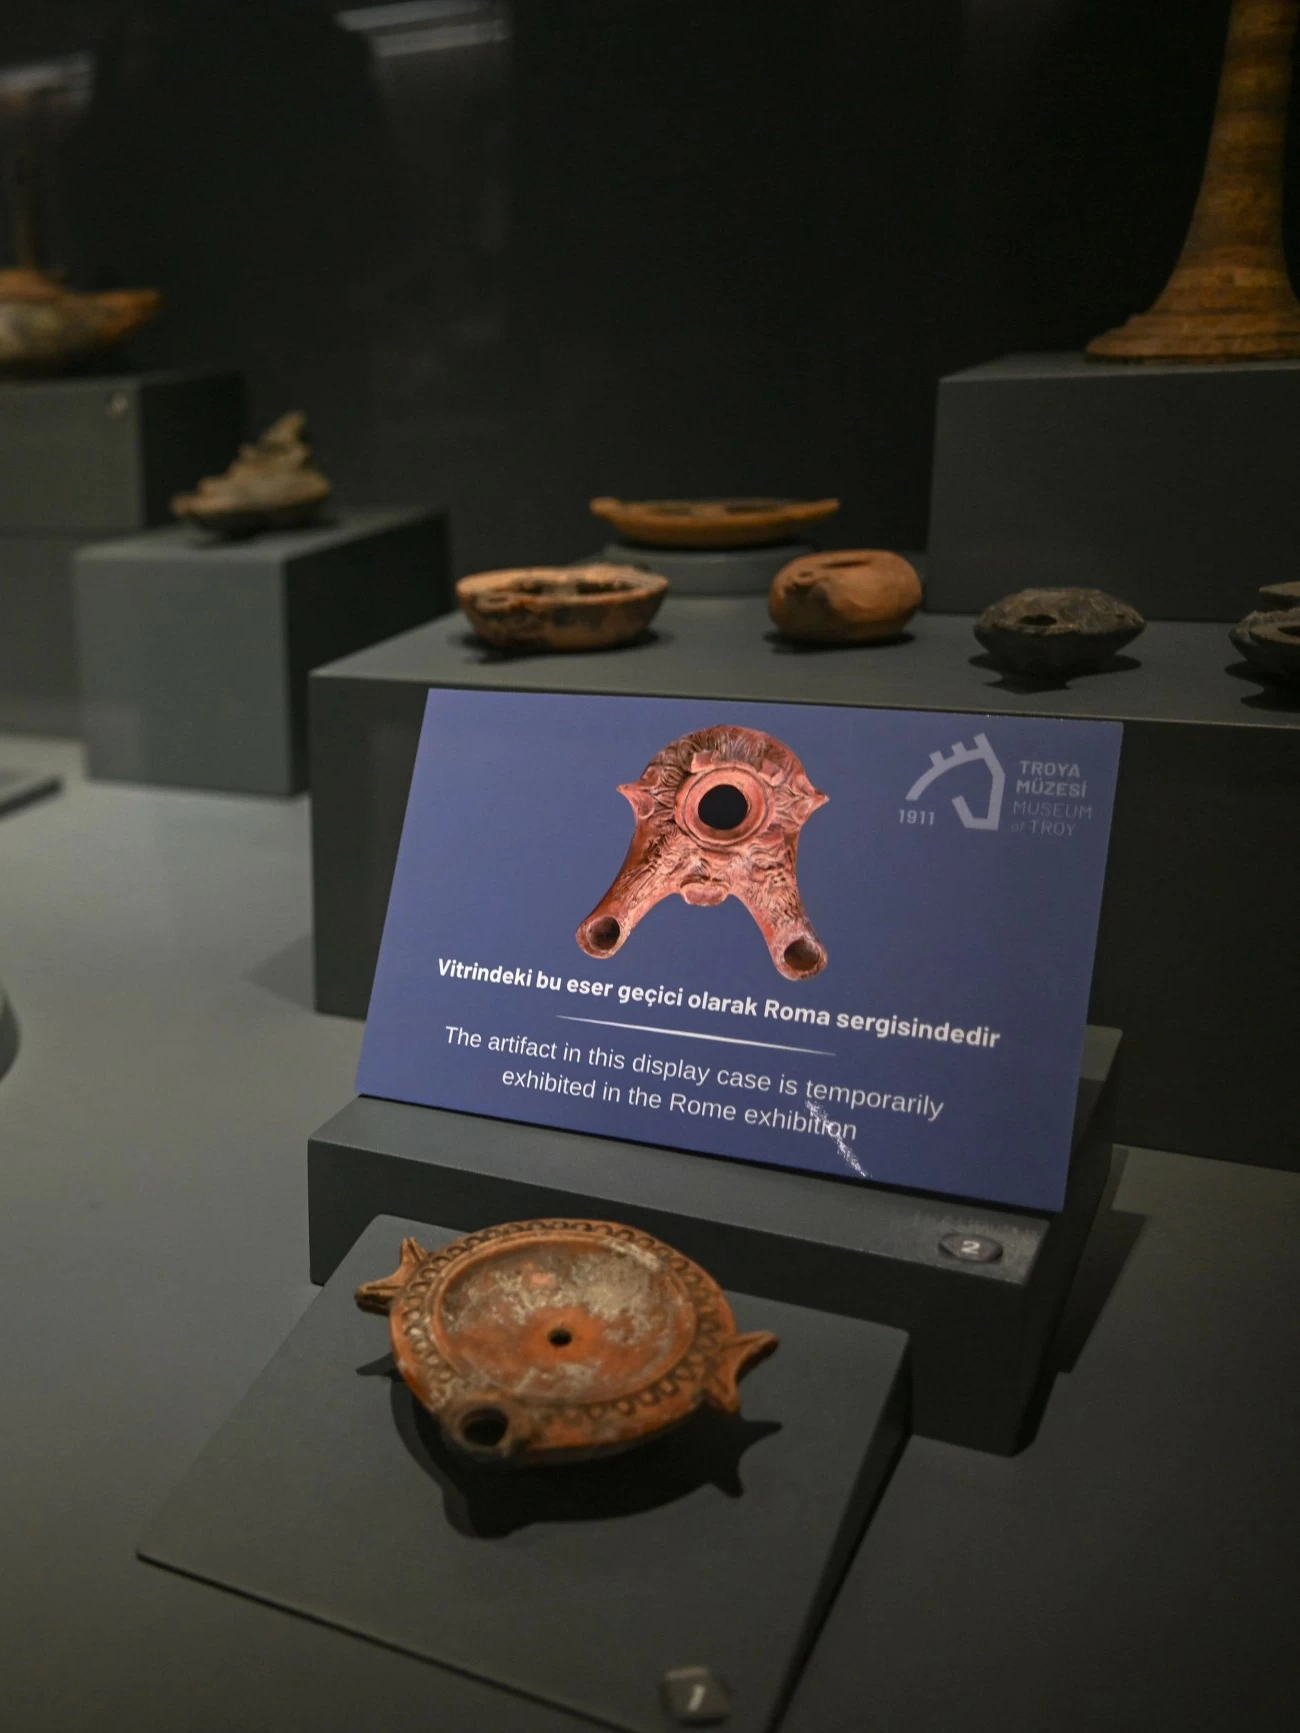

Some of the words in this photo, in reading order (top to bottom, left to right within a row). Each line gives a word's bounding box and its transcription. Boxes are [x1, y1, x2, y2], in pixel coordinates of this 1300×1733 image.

[1019, 759, 1081, 778] TROYA
[1015, 777, 1088, 799] MÜZESİ
[899, 809, 935, 826] 1911
[1012, 800, 1093, 820] MUSEUM
[1010, 821, 1026, 832] of
[1029, 820, 1077, 837] TROY
[438, 958, 532, 987] Vitrindeki
[536, 971, 562, 991] bu
[566, 978, 614, 998] eser
[617, 984, 684, 1007] geçici
[688, 992, 757, 1016] olarak
[763, 999, 831, 1026] Roma
[836, 1013, 1002, 1049] sergisindedir
[445, 1025, 482, 1048] The
[488, 1034, 557, 1060] artifact
[563, 1042, 581, 1063] in
[588, 1046, 626, 1070] this
[632, 1053, 711, 1086] display
[716, 1069, 771, 1092] case
[779, 1073, 798, 1096] is
[806, 1079, 944, 1122] temporarily
[502, 1068, 596, 1098] exhibited
[602, 1081, 621, 1103] in
[628, 1086, 662, 1109] the
[669, 1092, 736, 1121] Rome
[744, 1104, 857, 1140] exhibition
[960, 1240, 980, 1255] 2
